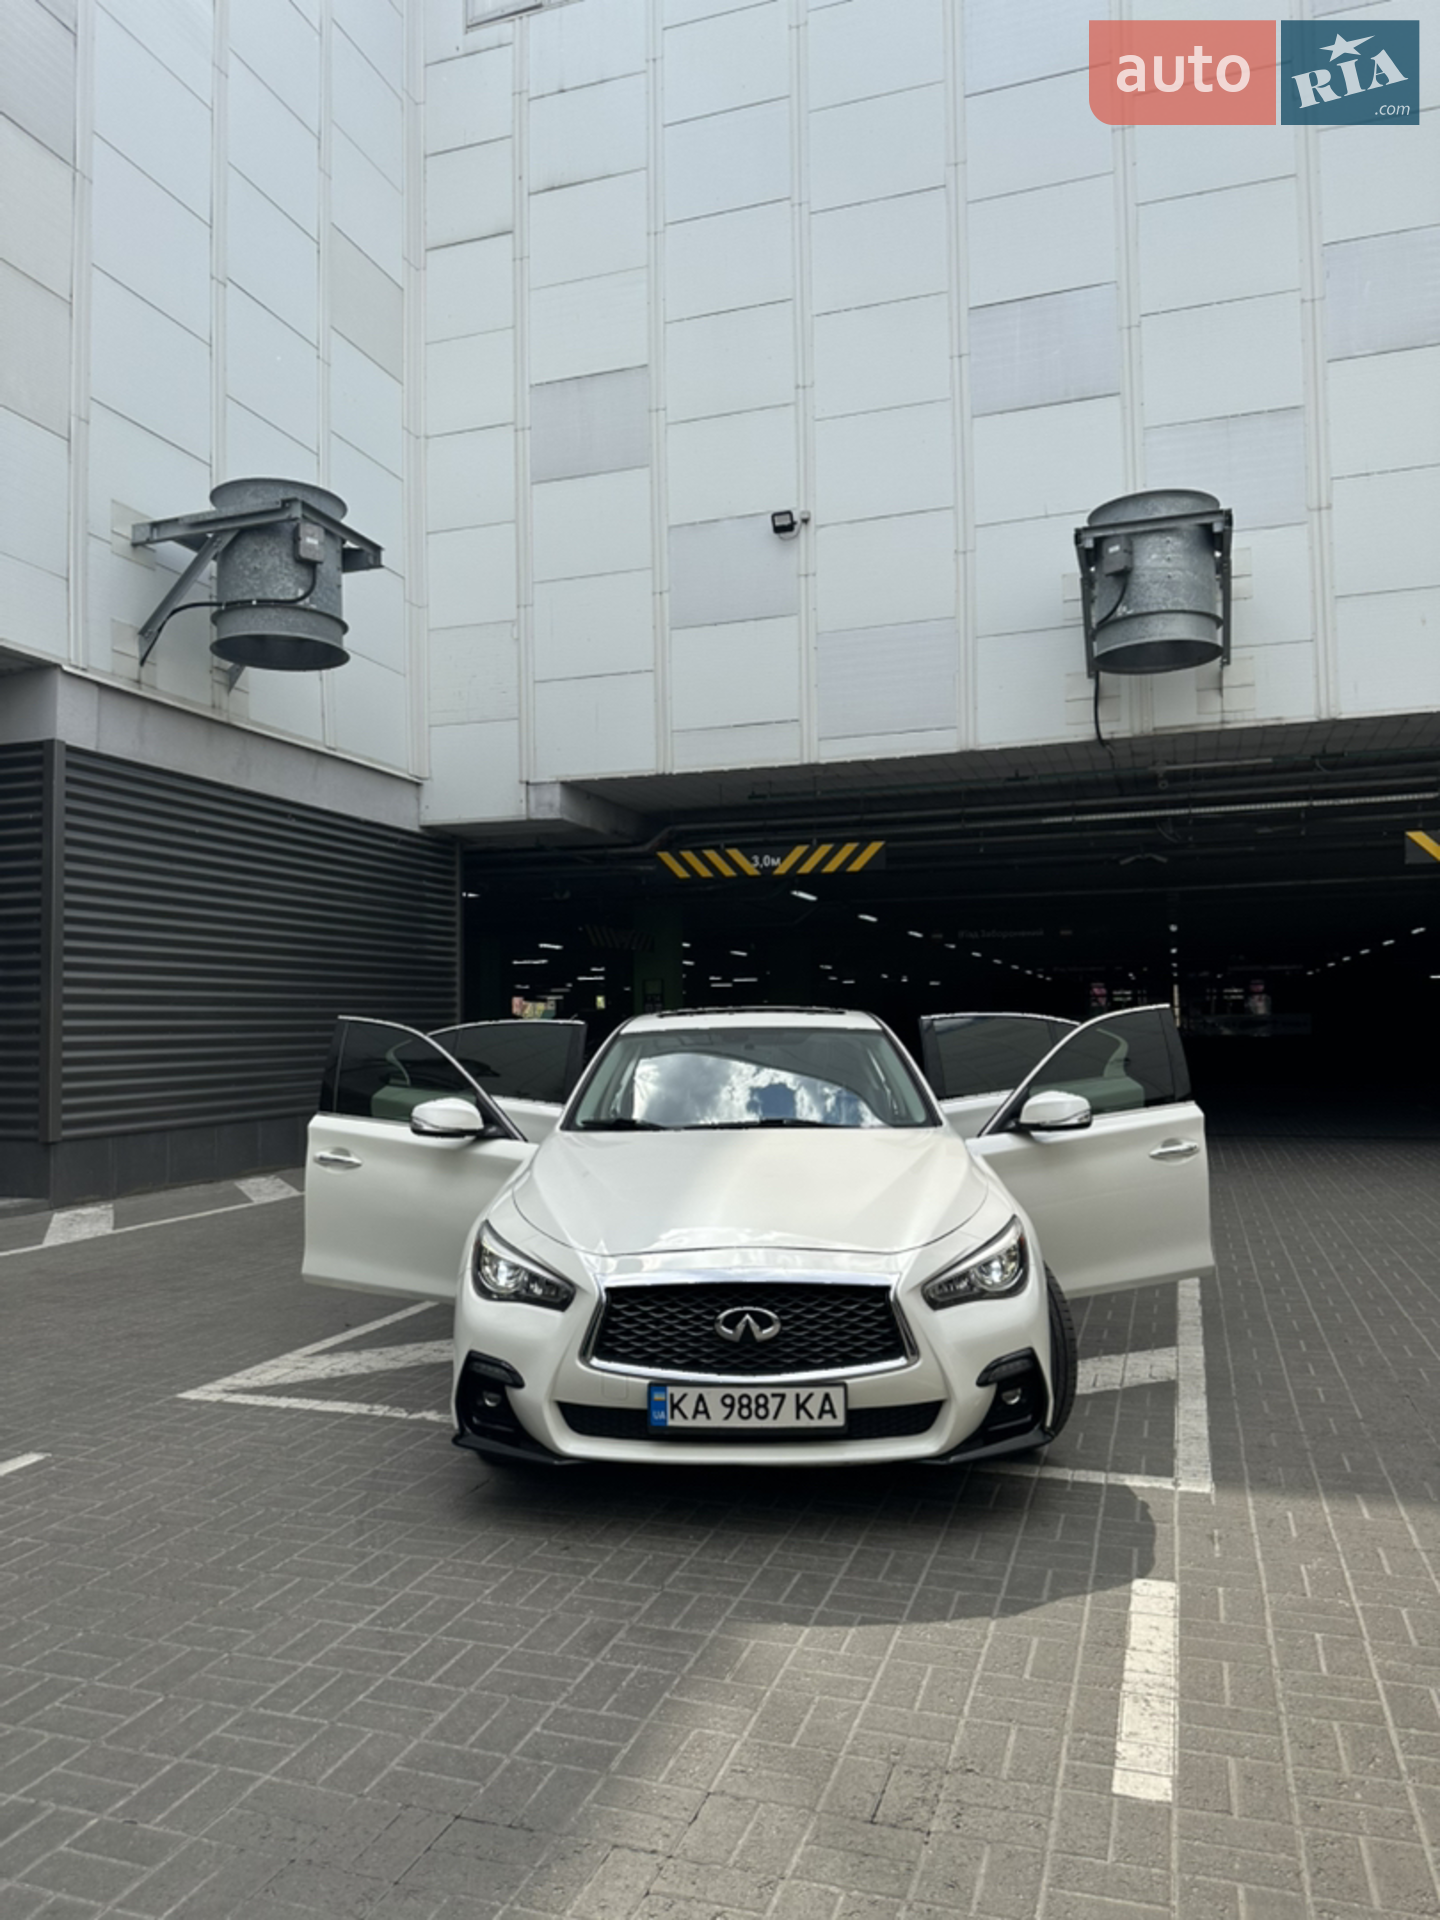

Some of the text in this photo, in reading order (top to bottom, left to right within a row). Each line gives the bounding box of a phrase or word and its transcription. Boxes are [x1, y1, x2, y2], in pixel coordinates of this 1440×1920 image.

[653, 1411, 666, 1420] UA
[669, 1392, 838, 1421] KA 9887 KA
